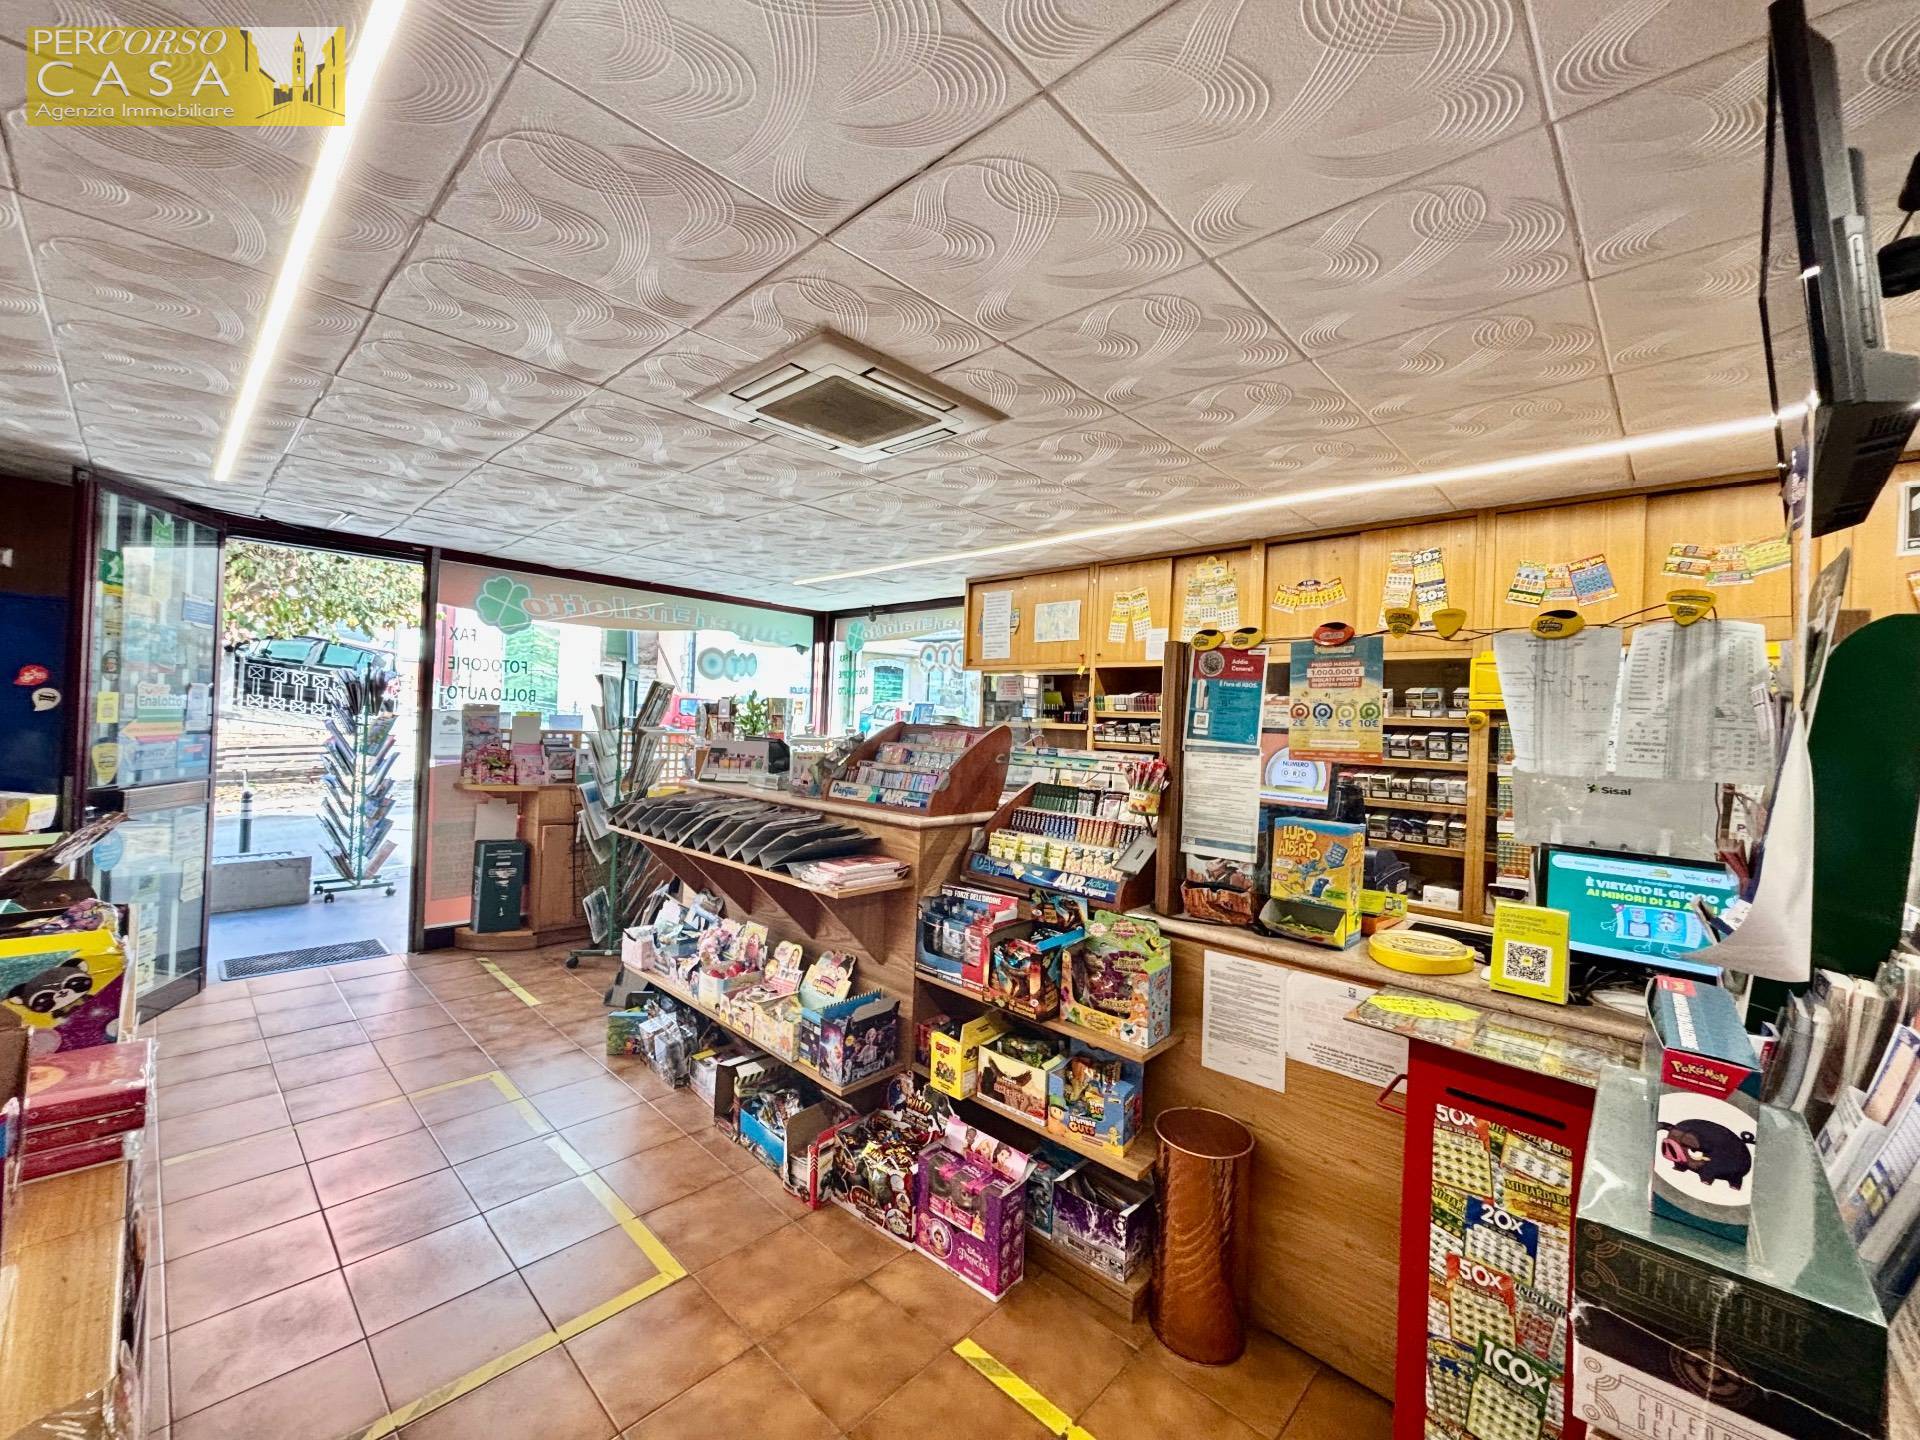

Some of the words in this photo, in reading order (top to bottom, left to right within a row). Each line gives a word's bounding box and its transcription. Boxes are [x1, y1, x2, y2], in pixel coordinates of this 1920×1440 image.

[1359, 720, 1379, 728] 10€
[1601, 786, 1632, 796] Sisal
[1282, 824, 1317, 844] LUPO
[1279, 840, 1321, 861] ALBERTO
[1596, 880, 1652, 896] VIETATO
[1654, 888, 1667, 897] IL
[1586, 889, 1600, 897] AI
[1601, 890, 1648, 904] MINORI
[1650, 896, 1663, 906] DI
[1665, 900, 1681, 909] 18
[1067, 1122, 1096, 1137] GUYS
